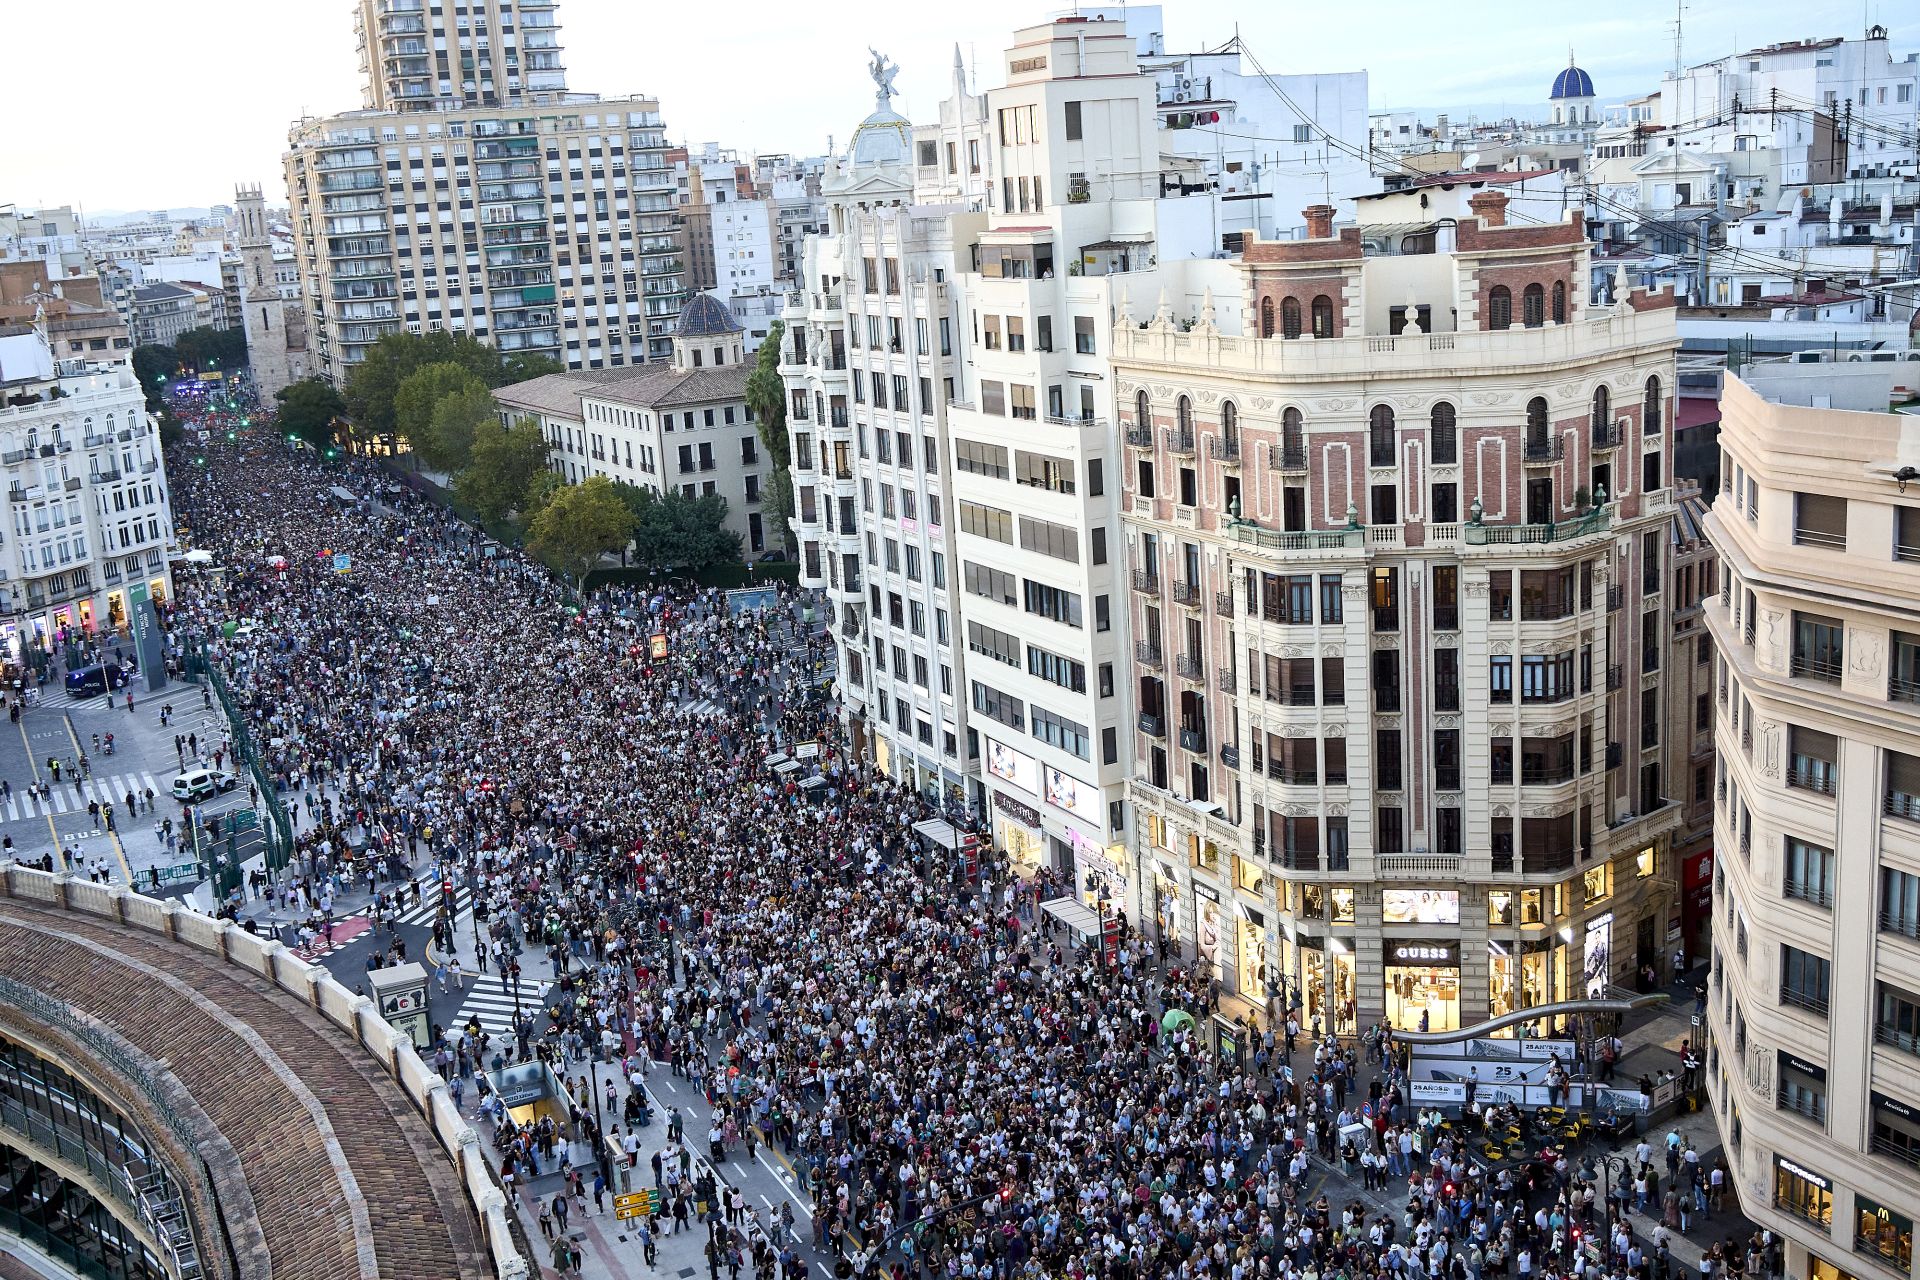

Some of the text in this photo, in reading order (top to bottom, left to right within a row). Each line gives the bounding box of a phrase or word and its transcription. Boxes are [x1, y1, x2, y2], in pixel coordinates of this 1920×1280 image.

[64, 829, 102, 841] BUS
[1194, 884, 1216, 900] GUESS
[1587, 912, 1615, 931] GUESS
[1396, 947, 1448, 959] GUESS
[1495, 1066, 1512, 1076] 25
[1780, 1158, 1826, 1187] McDonald's
